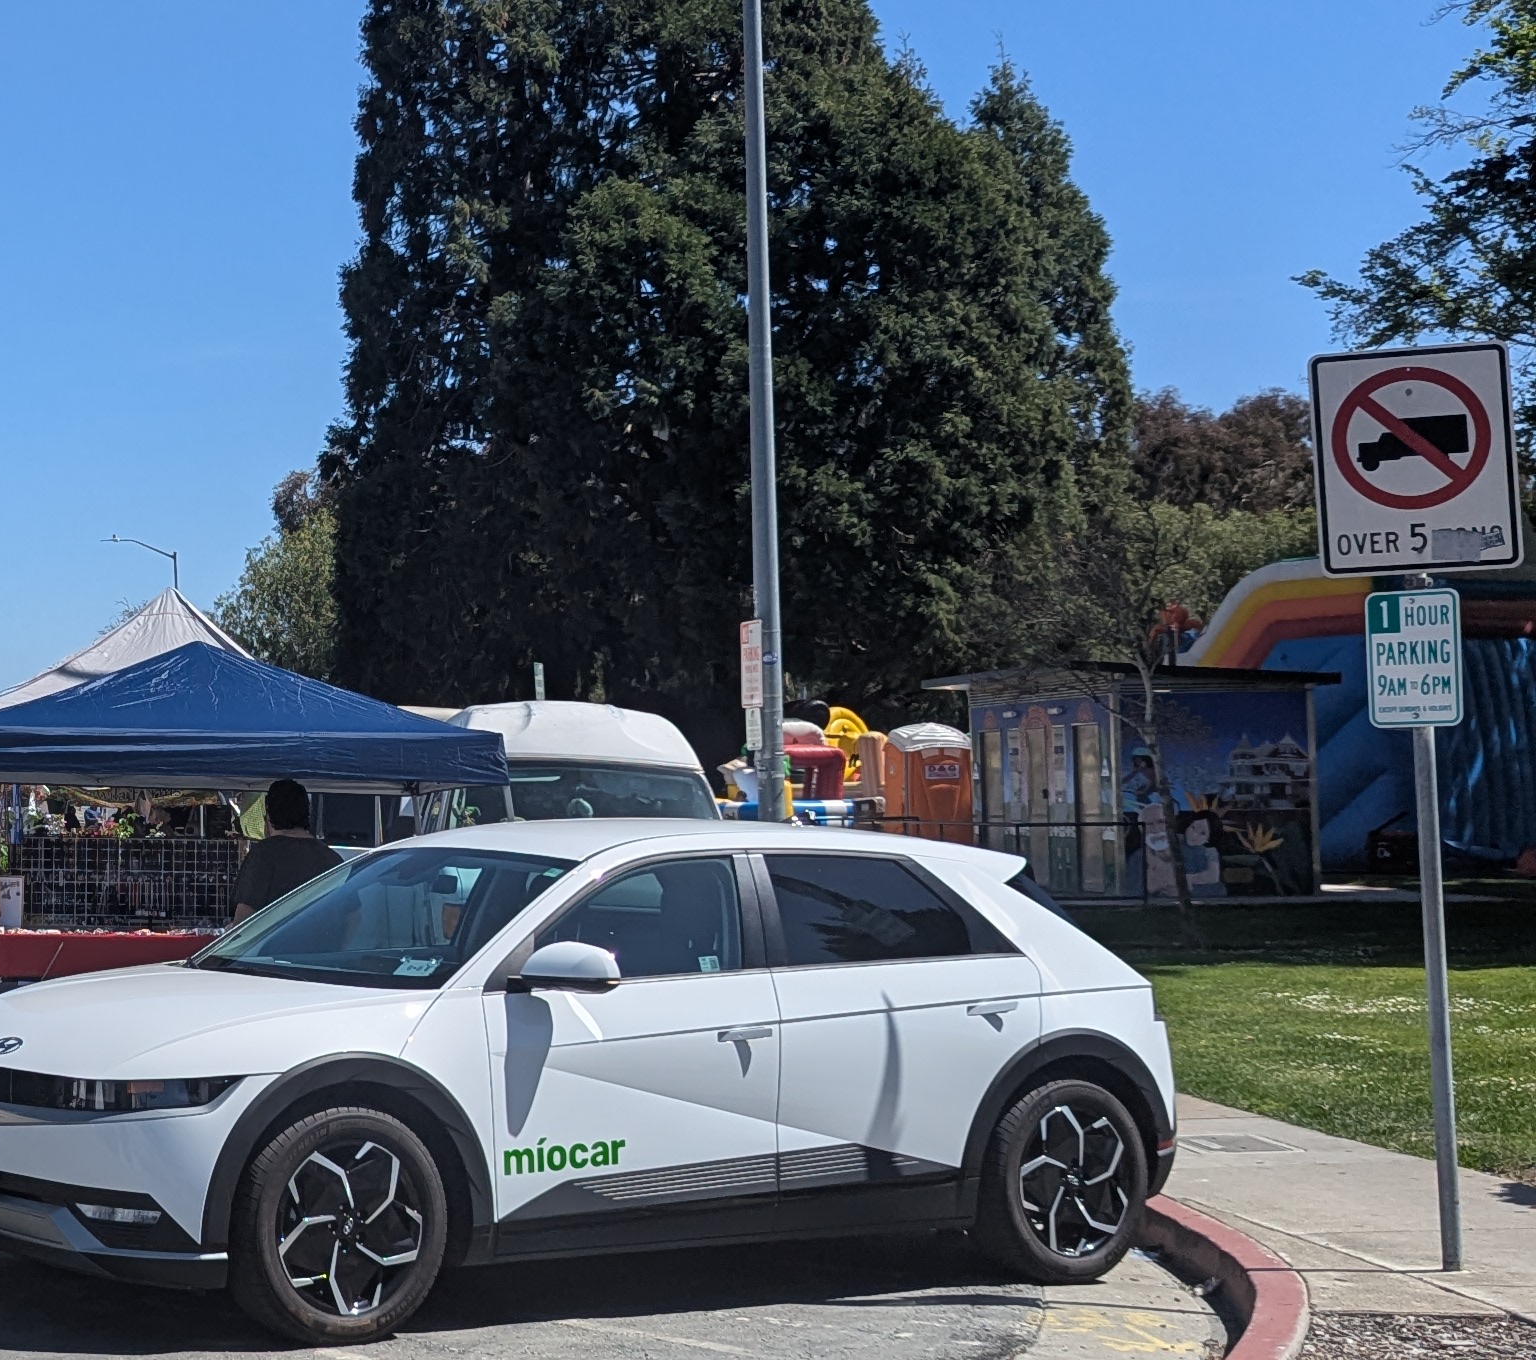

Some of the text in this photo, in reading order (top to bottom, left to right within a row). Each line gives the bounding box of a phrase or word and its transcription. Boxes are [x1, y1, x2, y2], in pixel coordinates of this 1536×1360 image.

[1337, 531, 1400, 556] OVER
[1409, 522, 1428, 554] 5
[1379, 600, 1450, 629] 1 HOUR
[1375, 638, 1451, 666] PARKING
[1377, 674, 1407, 697] 9AM
[1420, 673, 1452, 696] 6PM
